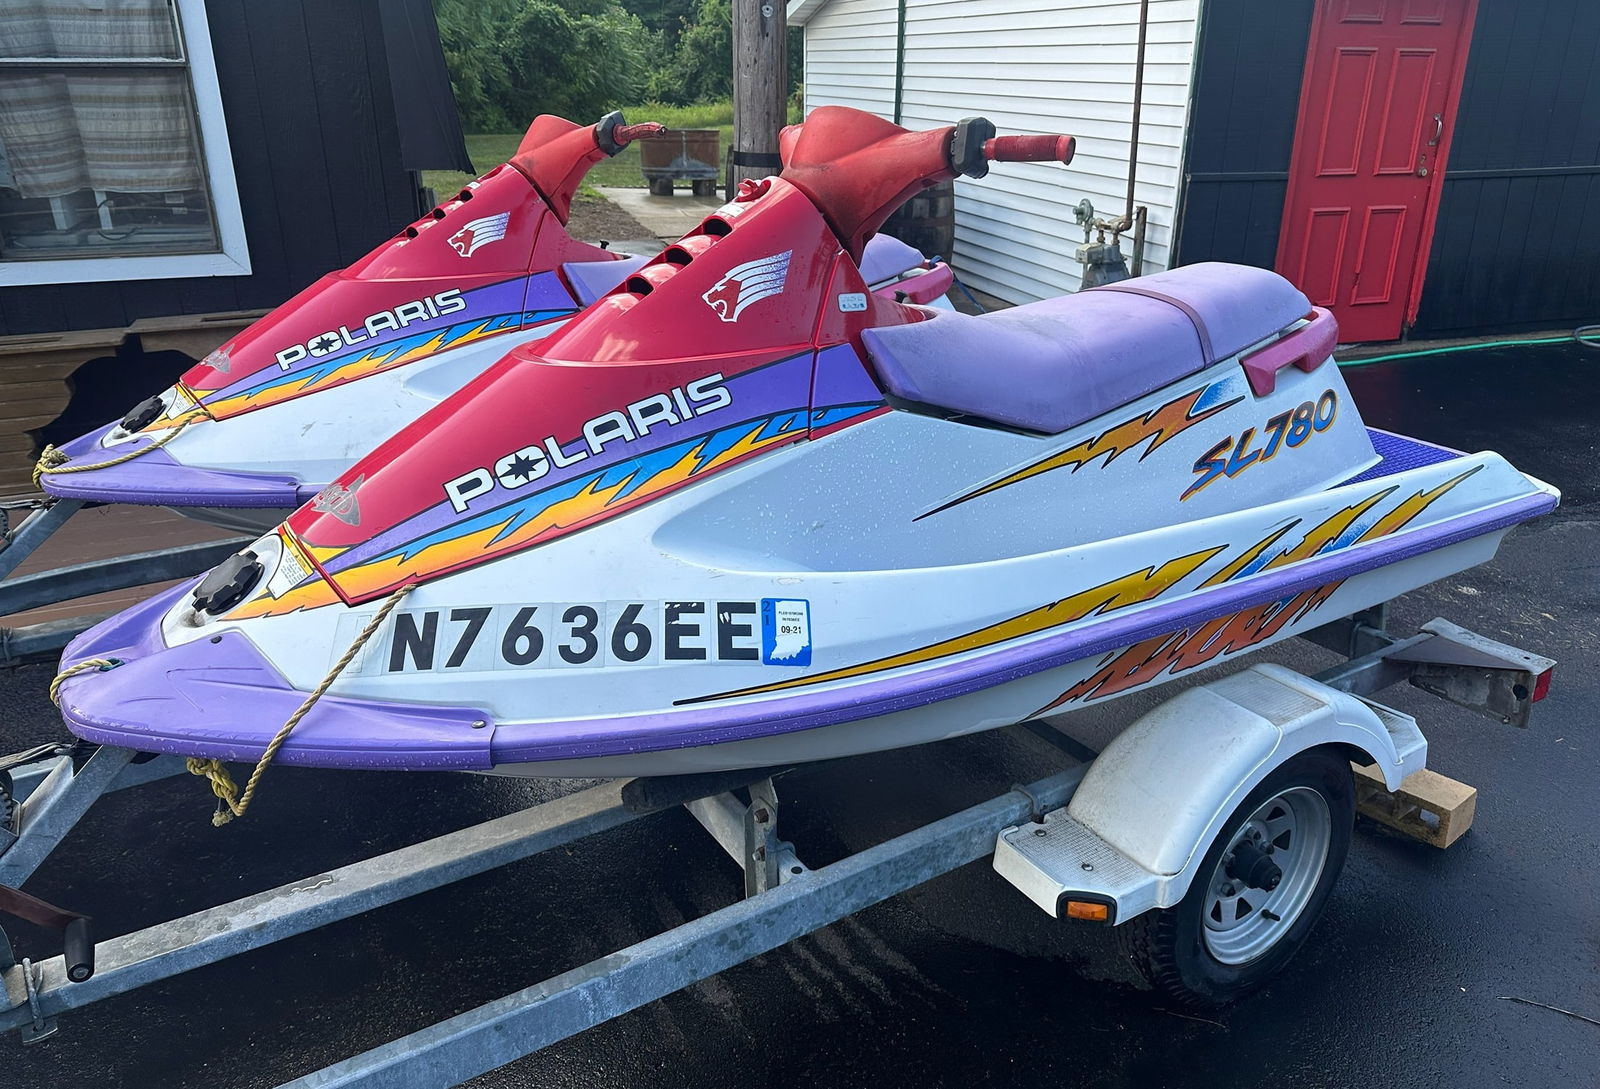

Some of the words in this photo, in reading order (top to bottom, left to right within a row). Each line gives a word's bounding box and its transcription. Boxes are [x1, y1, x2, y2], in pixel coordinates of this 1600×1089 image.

[275, 288, 467, 371] POLARIS
[443, 372, 732, 514] POLARIS
[1179, 388, 1339, 502] SL780
[388, 601, 760, 672] N7636EE
[781, 625, 802, 635] 09-21
